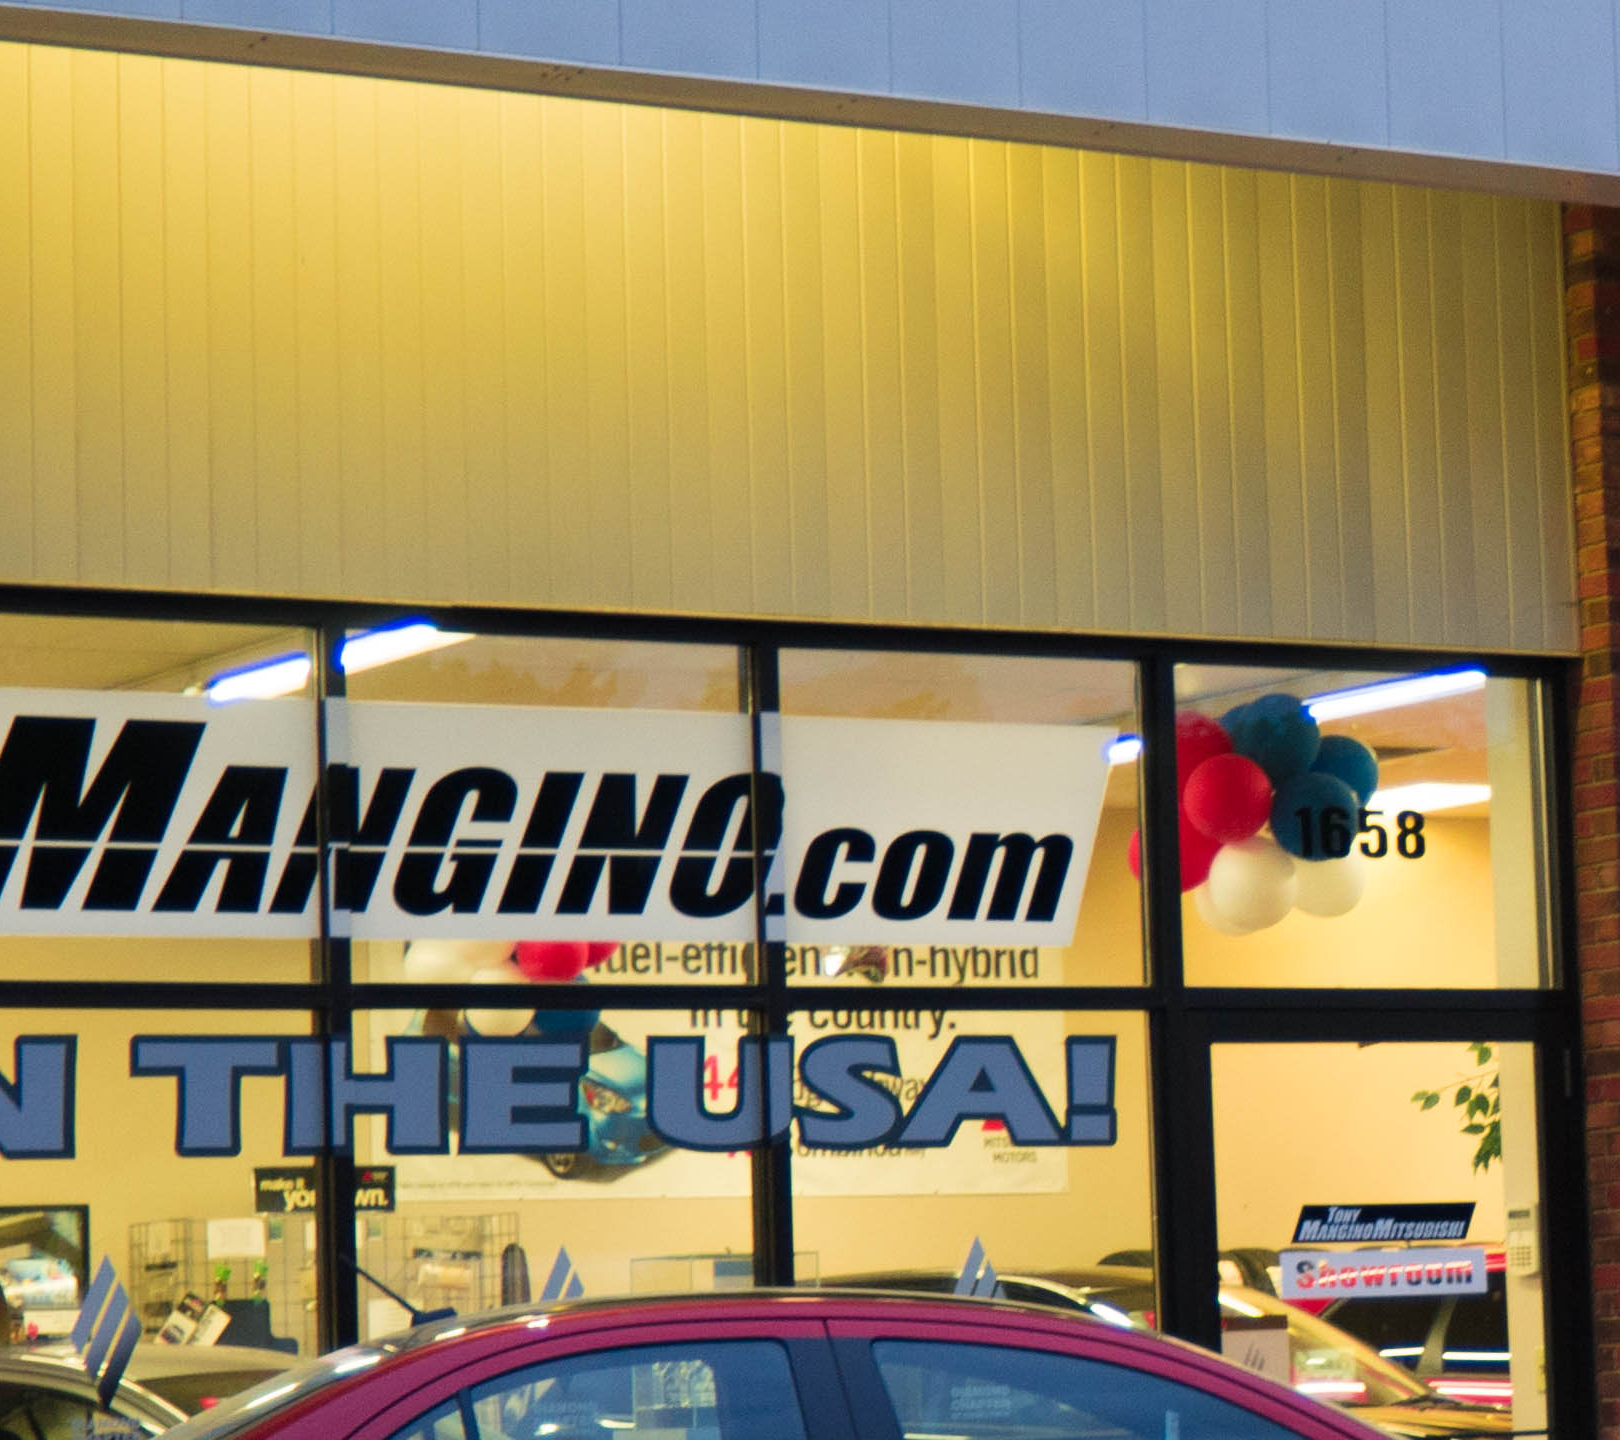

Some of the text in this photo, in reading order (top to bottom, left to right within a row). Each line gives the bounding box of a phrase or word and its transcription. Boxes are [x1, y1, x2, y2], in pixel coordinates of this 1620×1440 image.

[1294, 806, 1427, 860] 1658
[129, 1034, 593, 1157] THE
[645, 1034, 1119, 1155] USA!
[1327, 1205, 1363, 1224] TONY
[1295, 1259, 1475, 1290] Showroom
